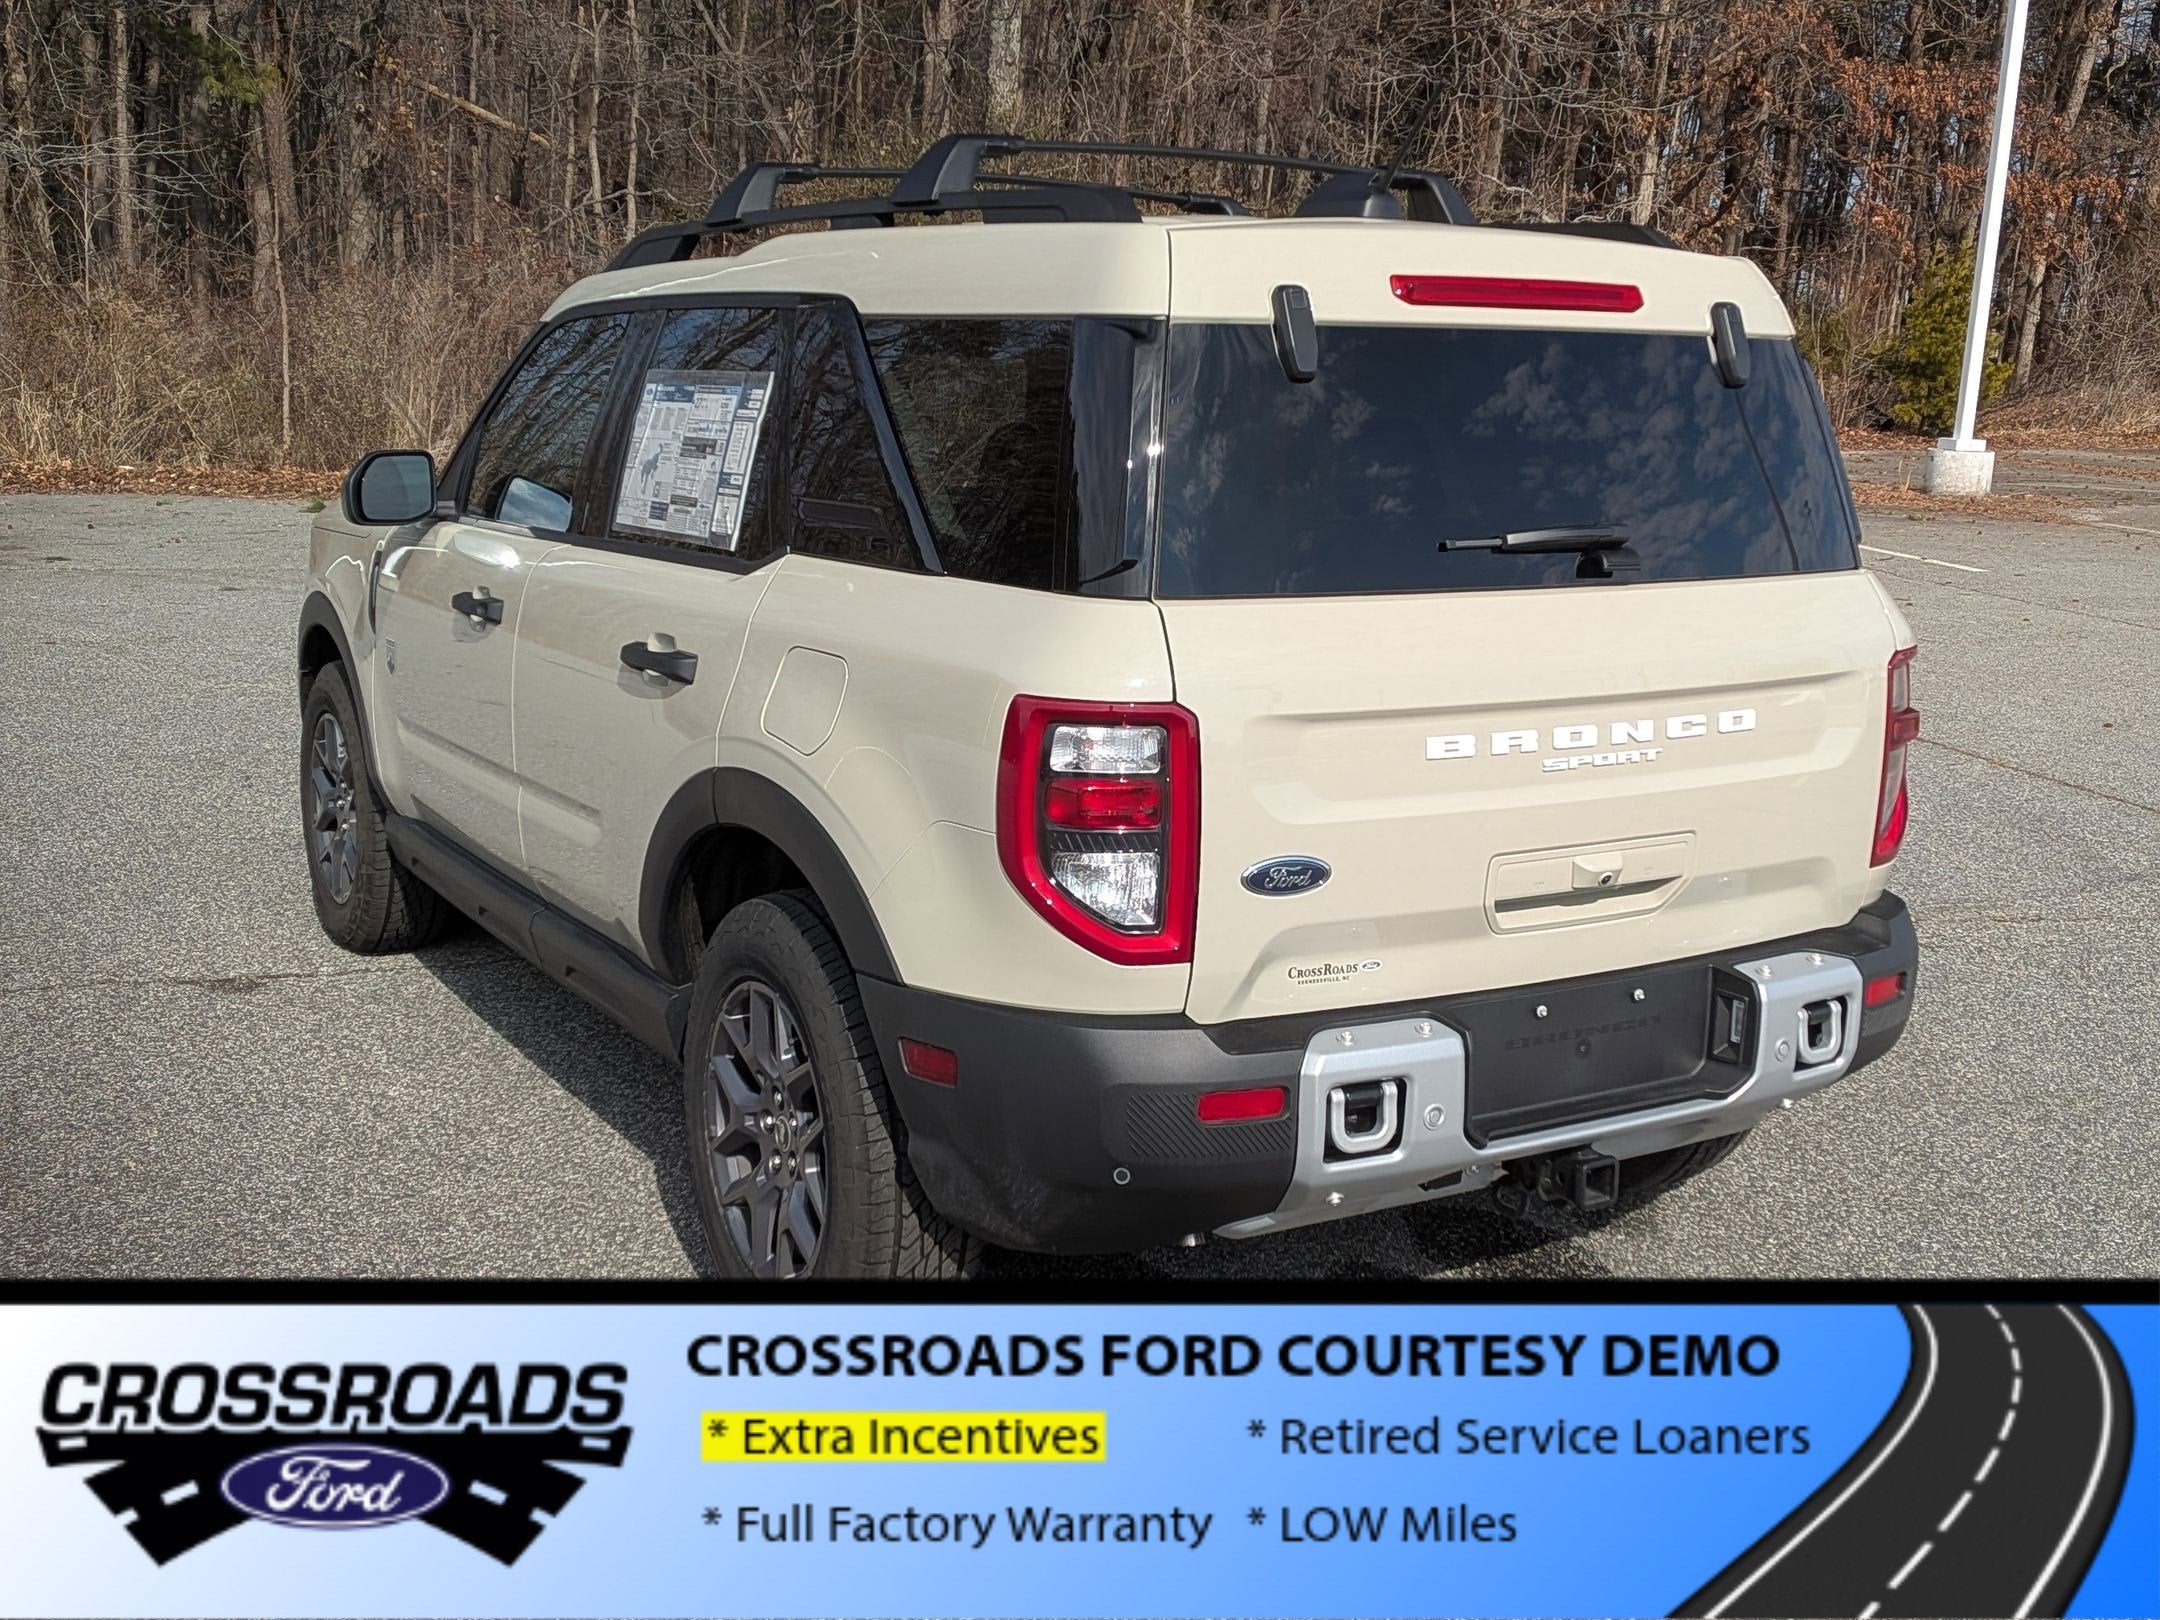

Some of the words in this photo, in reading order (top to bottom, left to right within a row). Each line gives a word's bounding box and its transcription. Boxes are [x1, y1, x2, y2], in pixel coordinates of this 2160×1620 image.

[1425, 708, 1757, 761] BRONCO
[1542, 747, 1664, 773] SPORT
[1264, 866, 1313, 889] Ford
[1504, 1015, 1664, 1050] BRONCO
